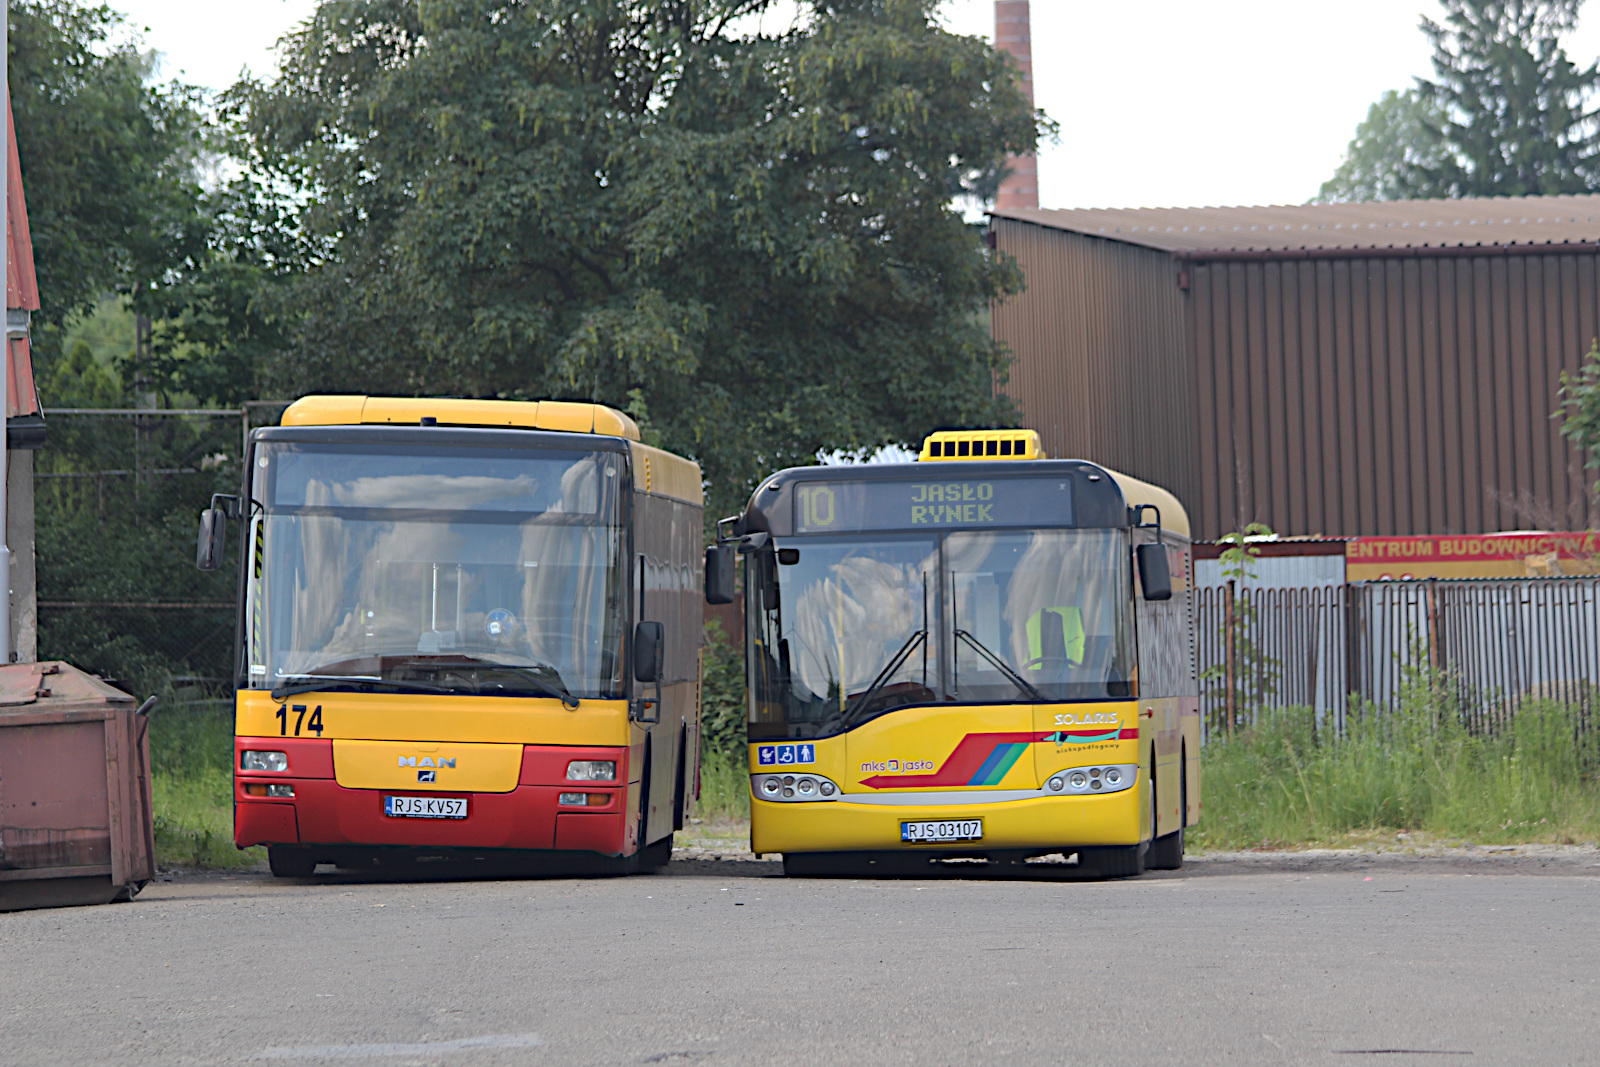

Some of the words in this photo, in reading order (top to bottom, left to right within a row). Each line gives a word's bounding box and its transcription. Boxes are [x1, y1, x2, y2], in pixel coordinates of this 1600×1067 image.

[911, 483, 994, 502] JASŁO
[798, 486, 835, 526] 10
[911, 504, 994, 524] RYNEK
[1439, 536, 1596, 556] BUDOWNICTWA
[276, 704, 324, 737] 174
[1054, 712, 1118, 726] SOLARIS
[398, 755, 457, 768] MAN
[861, 760, 886, 772] mks
[900, 758, 934, 774] jasło
[395, 798, 422, 813] RJS
[427, 800, 463, 815] KV57
[909, 824, 935, 837] RJS
[938, 822, 979, 837] 03107
